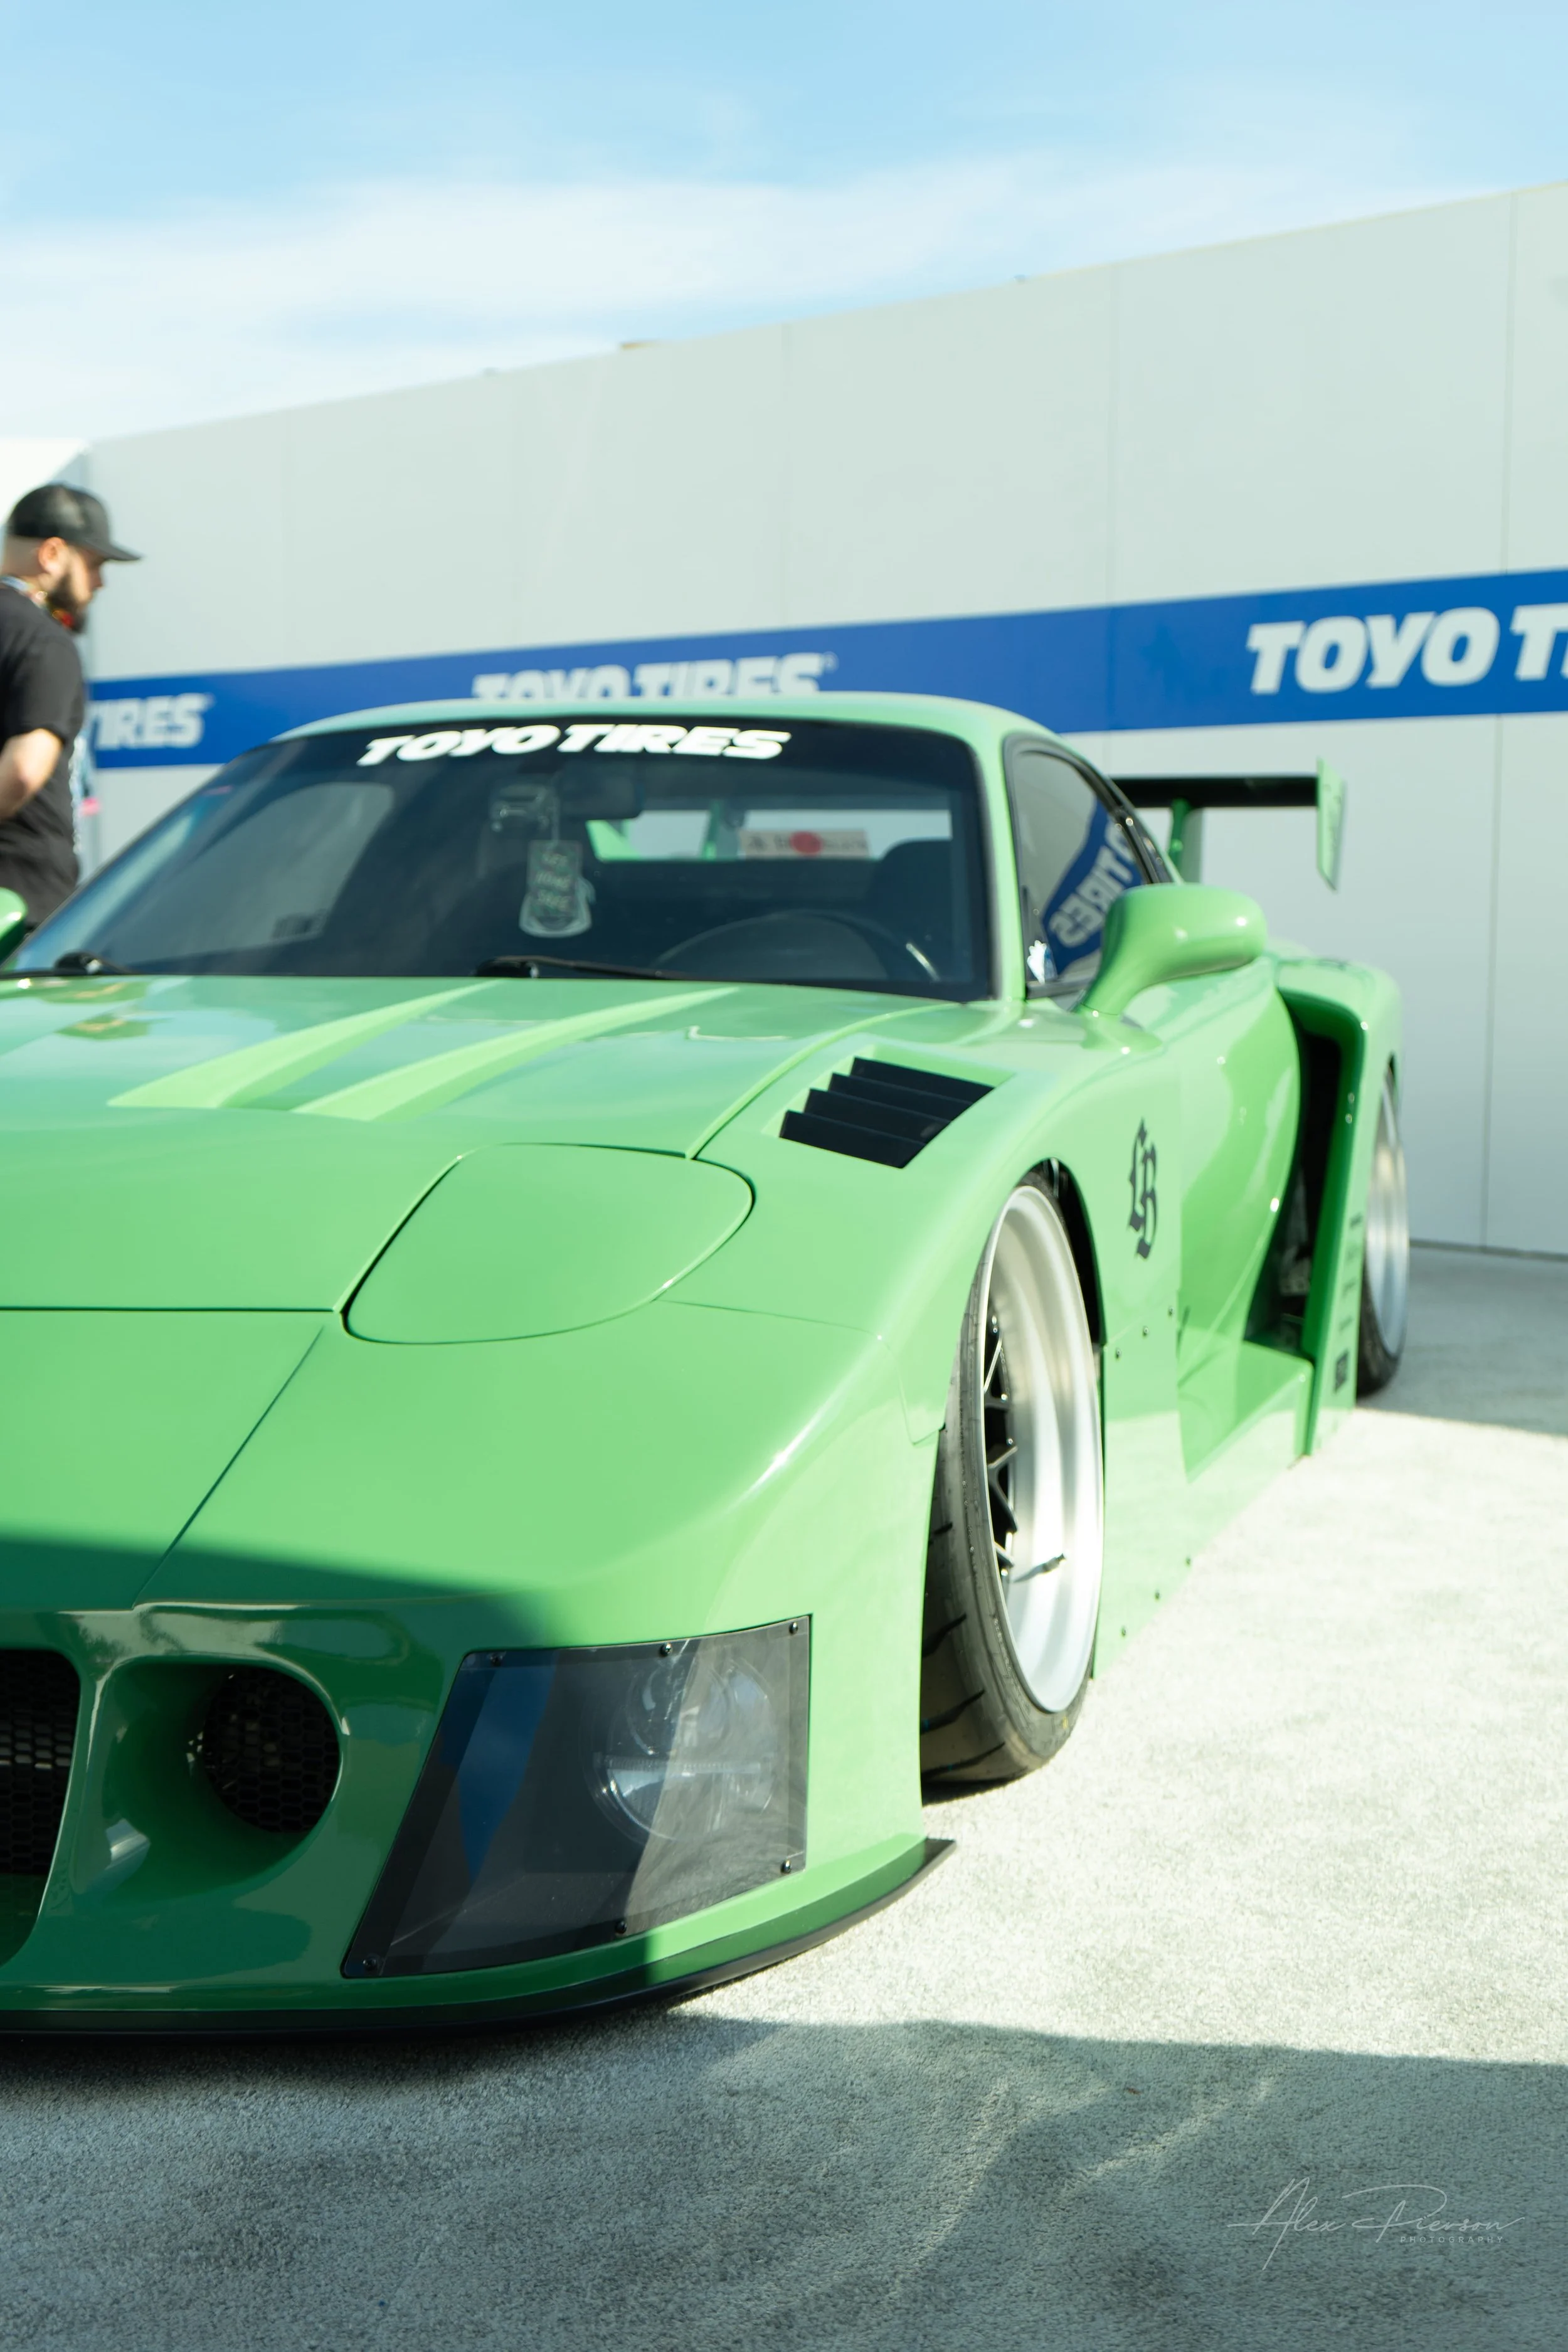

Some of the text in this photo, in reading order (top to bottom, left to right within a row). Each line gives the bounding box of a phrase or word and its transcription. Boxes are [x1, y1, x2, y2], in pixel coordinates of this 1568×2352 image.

[1246, 601, 1568, 695] TOYO T
[356, 724, 791, 766] TOYO TIRES
